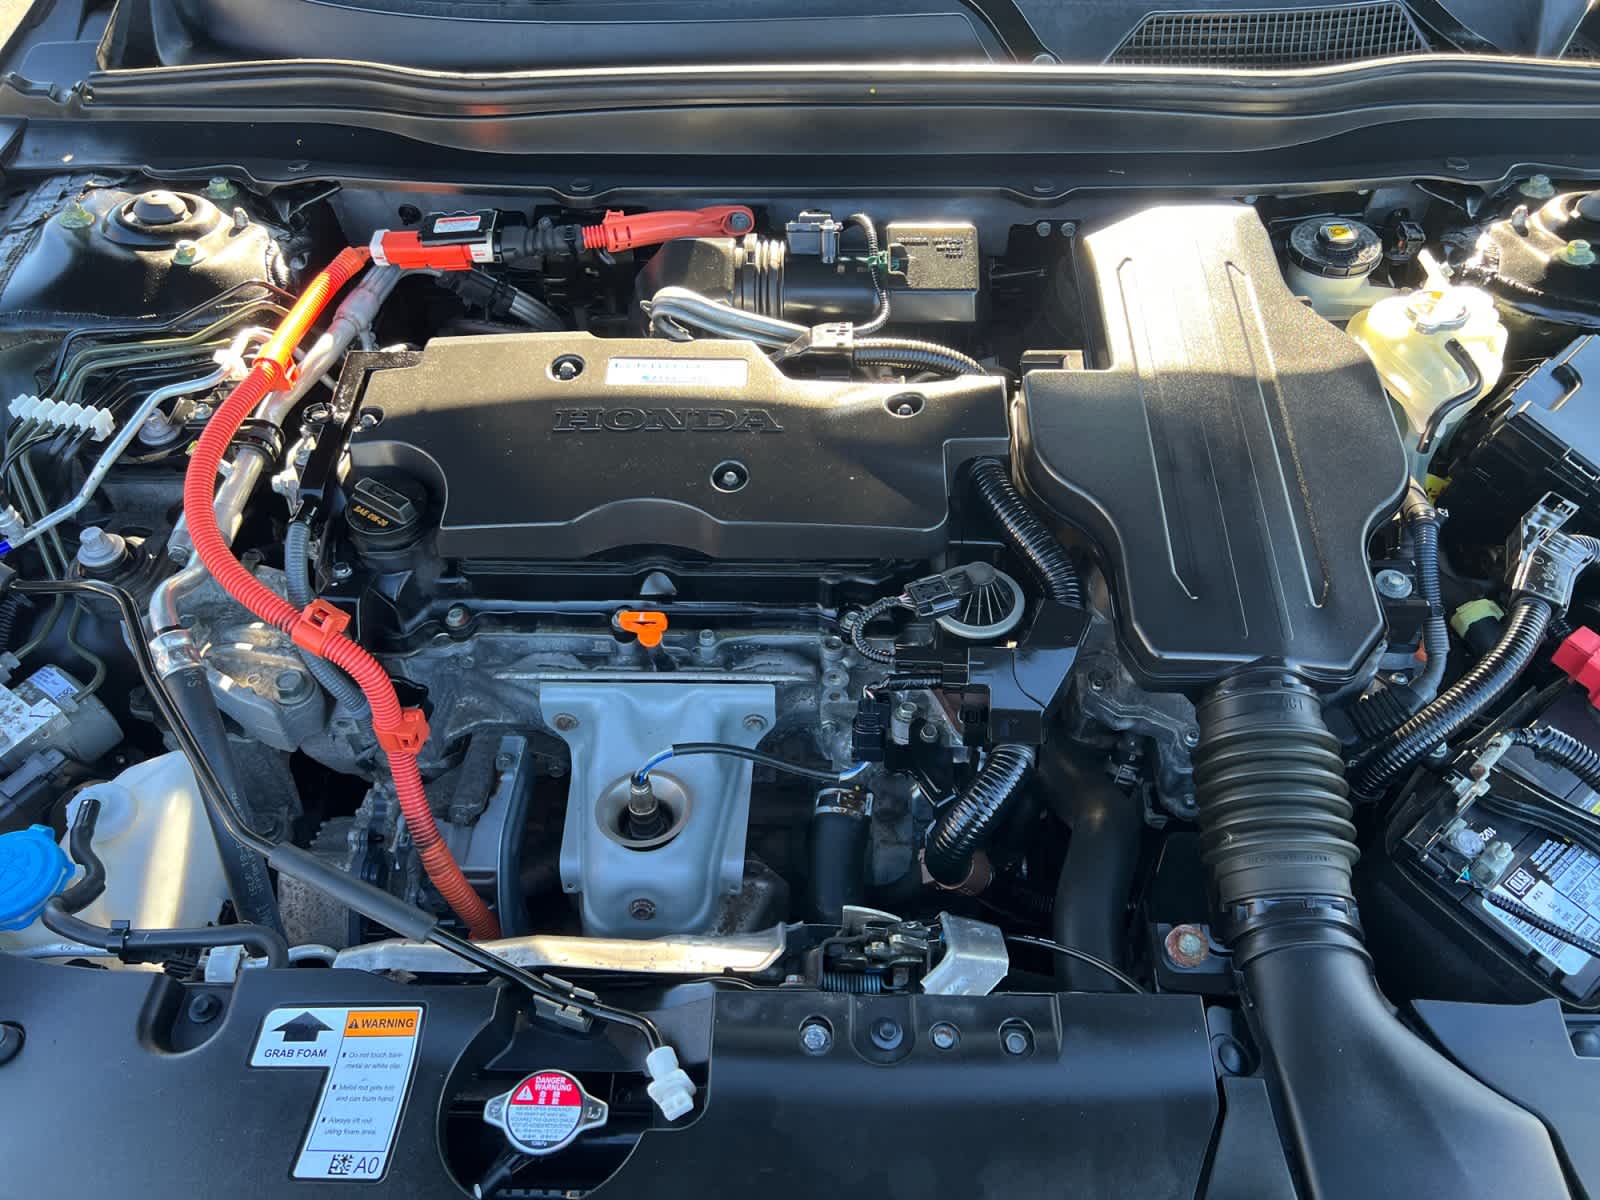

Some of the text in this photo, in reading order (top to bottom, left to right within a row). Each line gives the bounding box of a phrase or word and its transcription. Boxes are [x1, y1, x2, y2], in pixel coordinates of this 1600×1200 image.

[552, 407, 784, 433] HONDA
[362, 1018, 414, 1029] WARNING
[264, 1049, 328, 1058] GRAB FOAM
[535, 1076, 567, 1084] DANGER
[353, 1156, 380, 1175] A0
